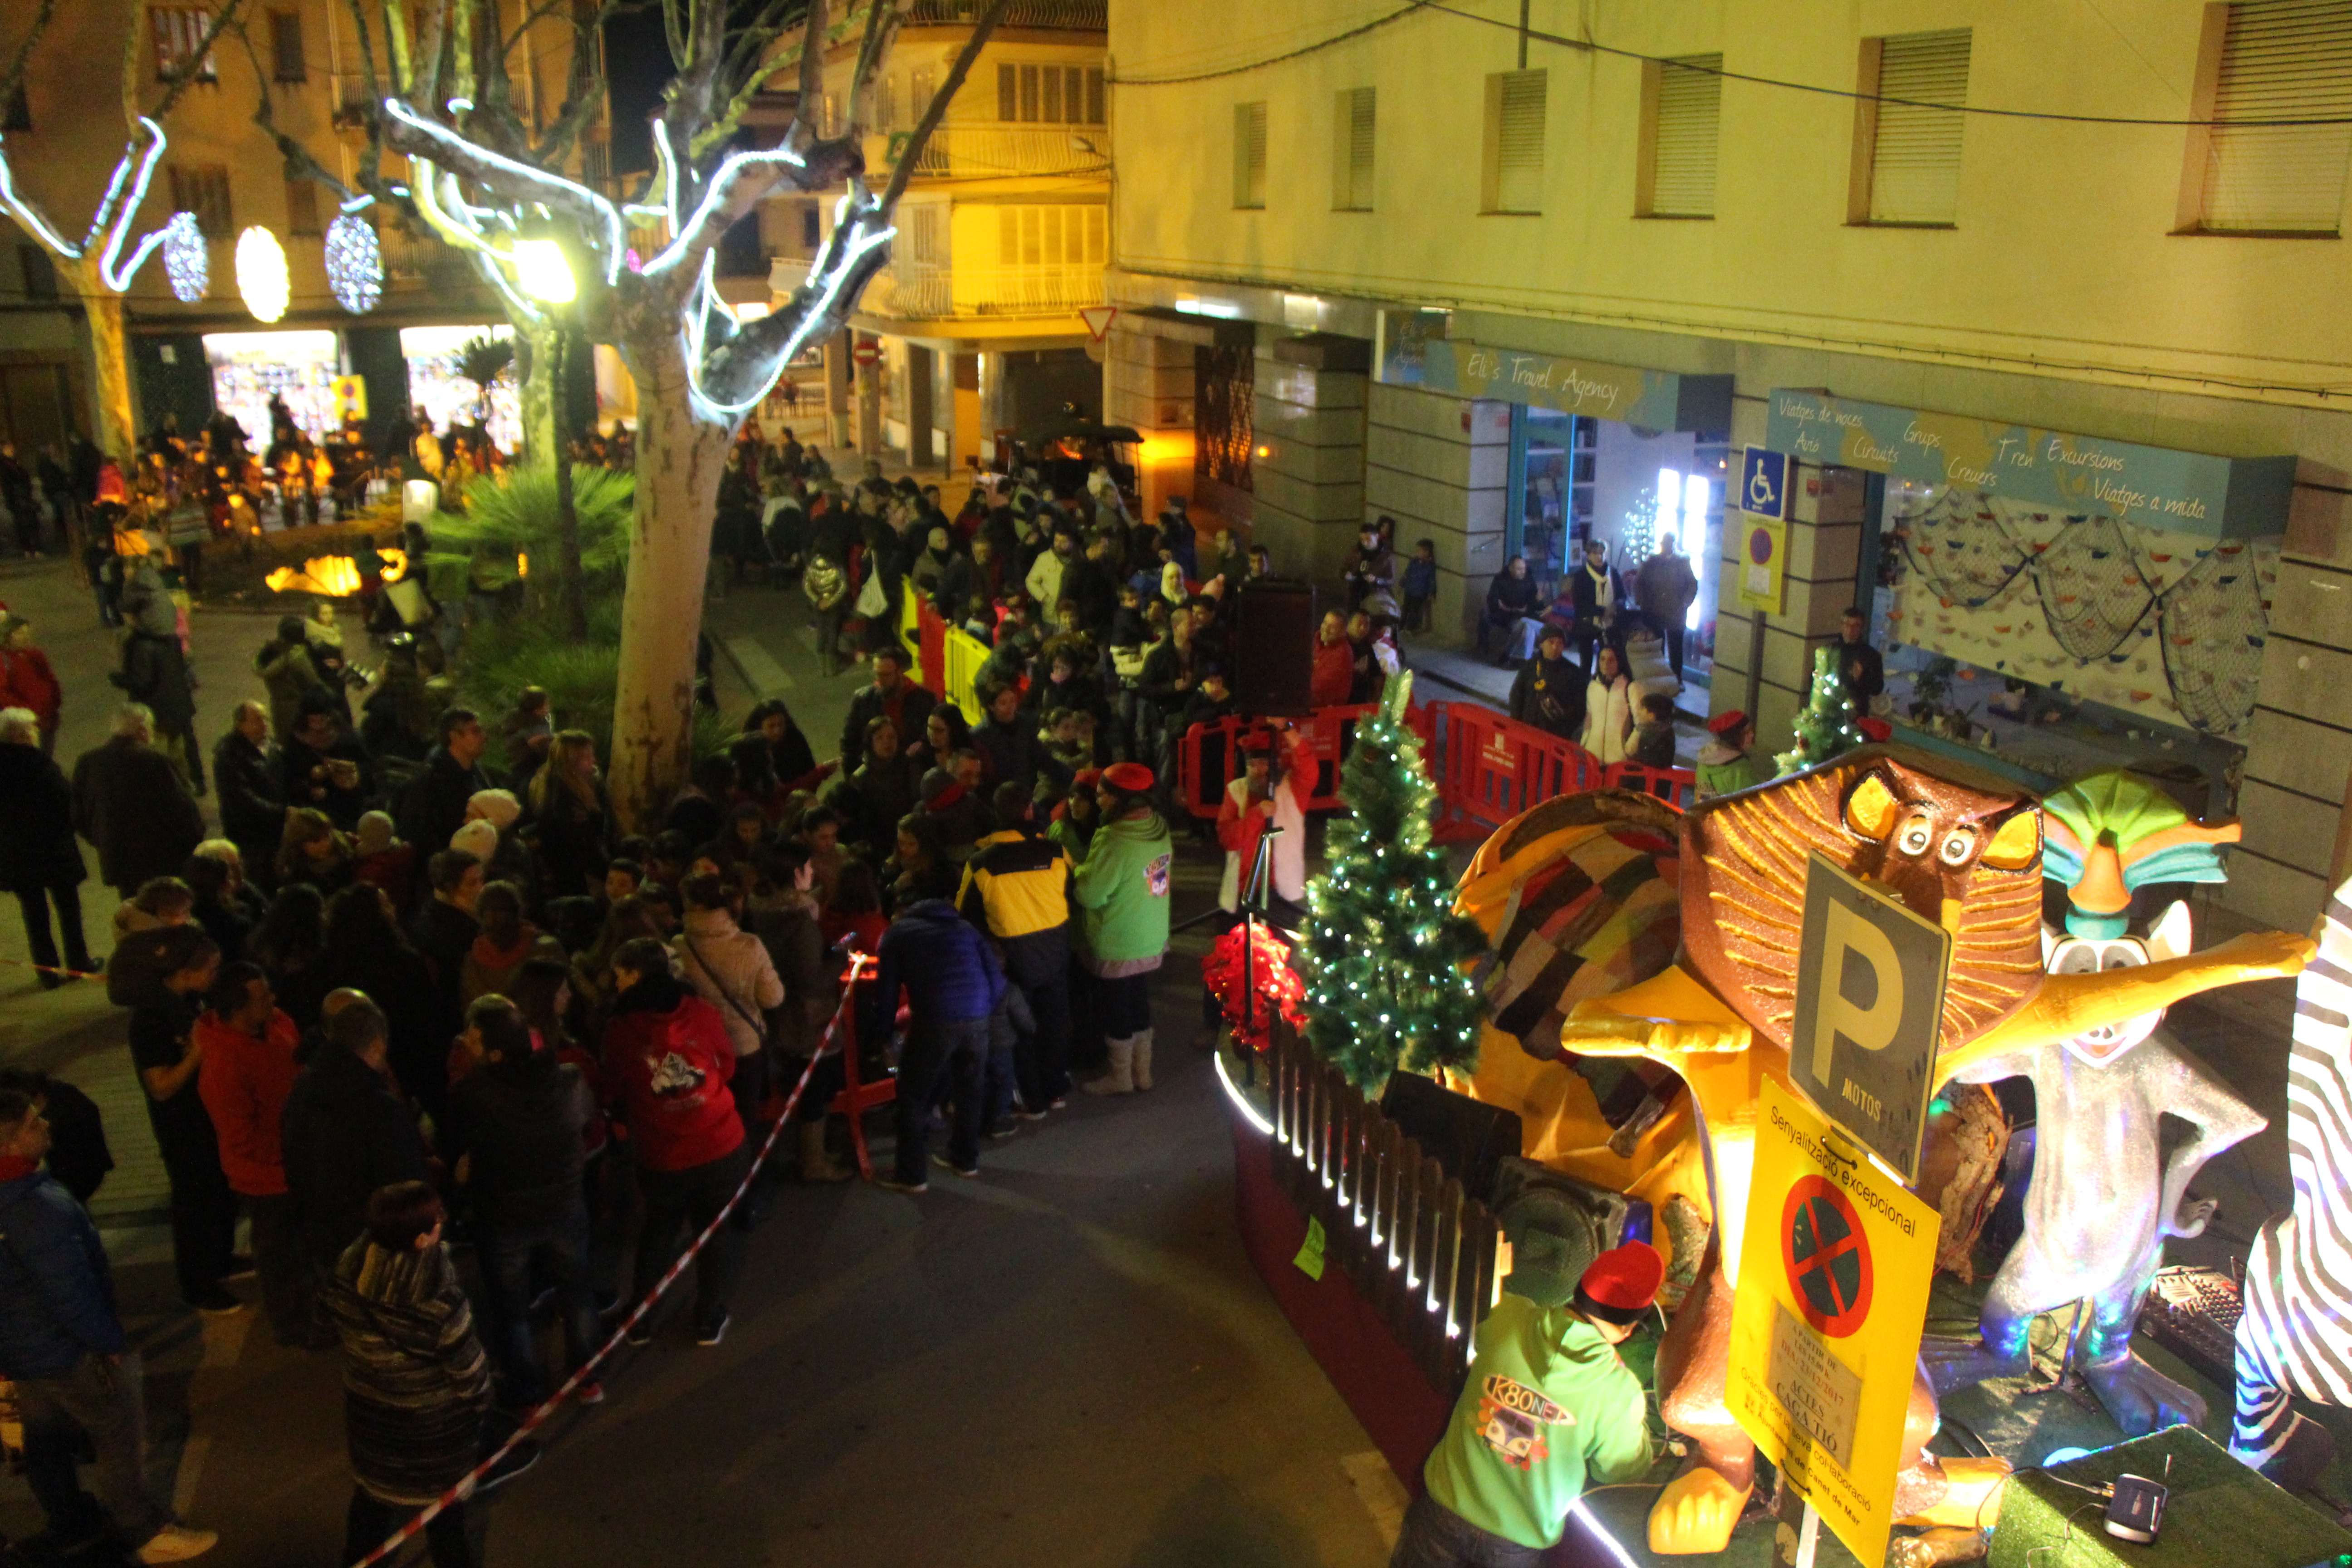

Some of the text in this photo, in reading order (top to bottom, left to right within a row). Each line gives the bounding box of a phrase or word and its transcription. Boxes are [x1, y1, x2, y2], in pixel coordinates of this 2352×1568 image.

[1511, 356, 1553, 389] Travel
[1562, 368, 1619, 411] Agency
[1779, 397, 1863, 428] Viatges de noces
[1853, 436, 1900, 463] Circuits
[1904, 420, 1942, 457] Grups
[1999, 438, 2034, 469] Tren
[2048, 439, 2125, 472] Excursions
[1948, 456, 1998, 487] Creuers
[2094, 477, 2206, 519] Viatges a mida
[1812, 896, 1904, 1089] P
[1841, 1078, 1882, 1122] MOTOS
[1770, 1106, 1915, 1239] Senyalització excepcional
[1798, 1330, 1824, 1358] PARTIR
[1790, 1379, 1824, 1417] ACTES
[1800, 1360, 1844, 1407] 23/12/2017
[1769, 1402, 1783, 1420] per
[1784, 1415, 1791, 1430] la
[1792, 1427, 1812, 1452] seva
[1777, 1382, 1838, 1452] CAGA TIÓ
[1795, 1456, 1805, 1470] de
[1808, 1467, 1830, 1495] Canet
[1832, 1492, 1842, 1508] de
[1844, 1505, 1860, 1526] Mar
